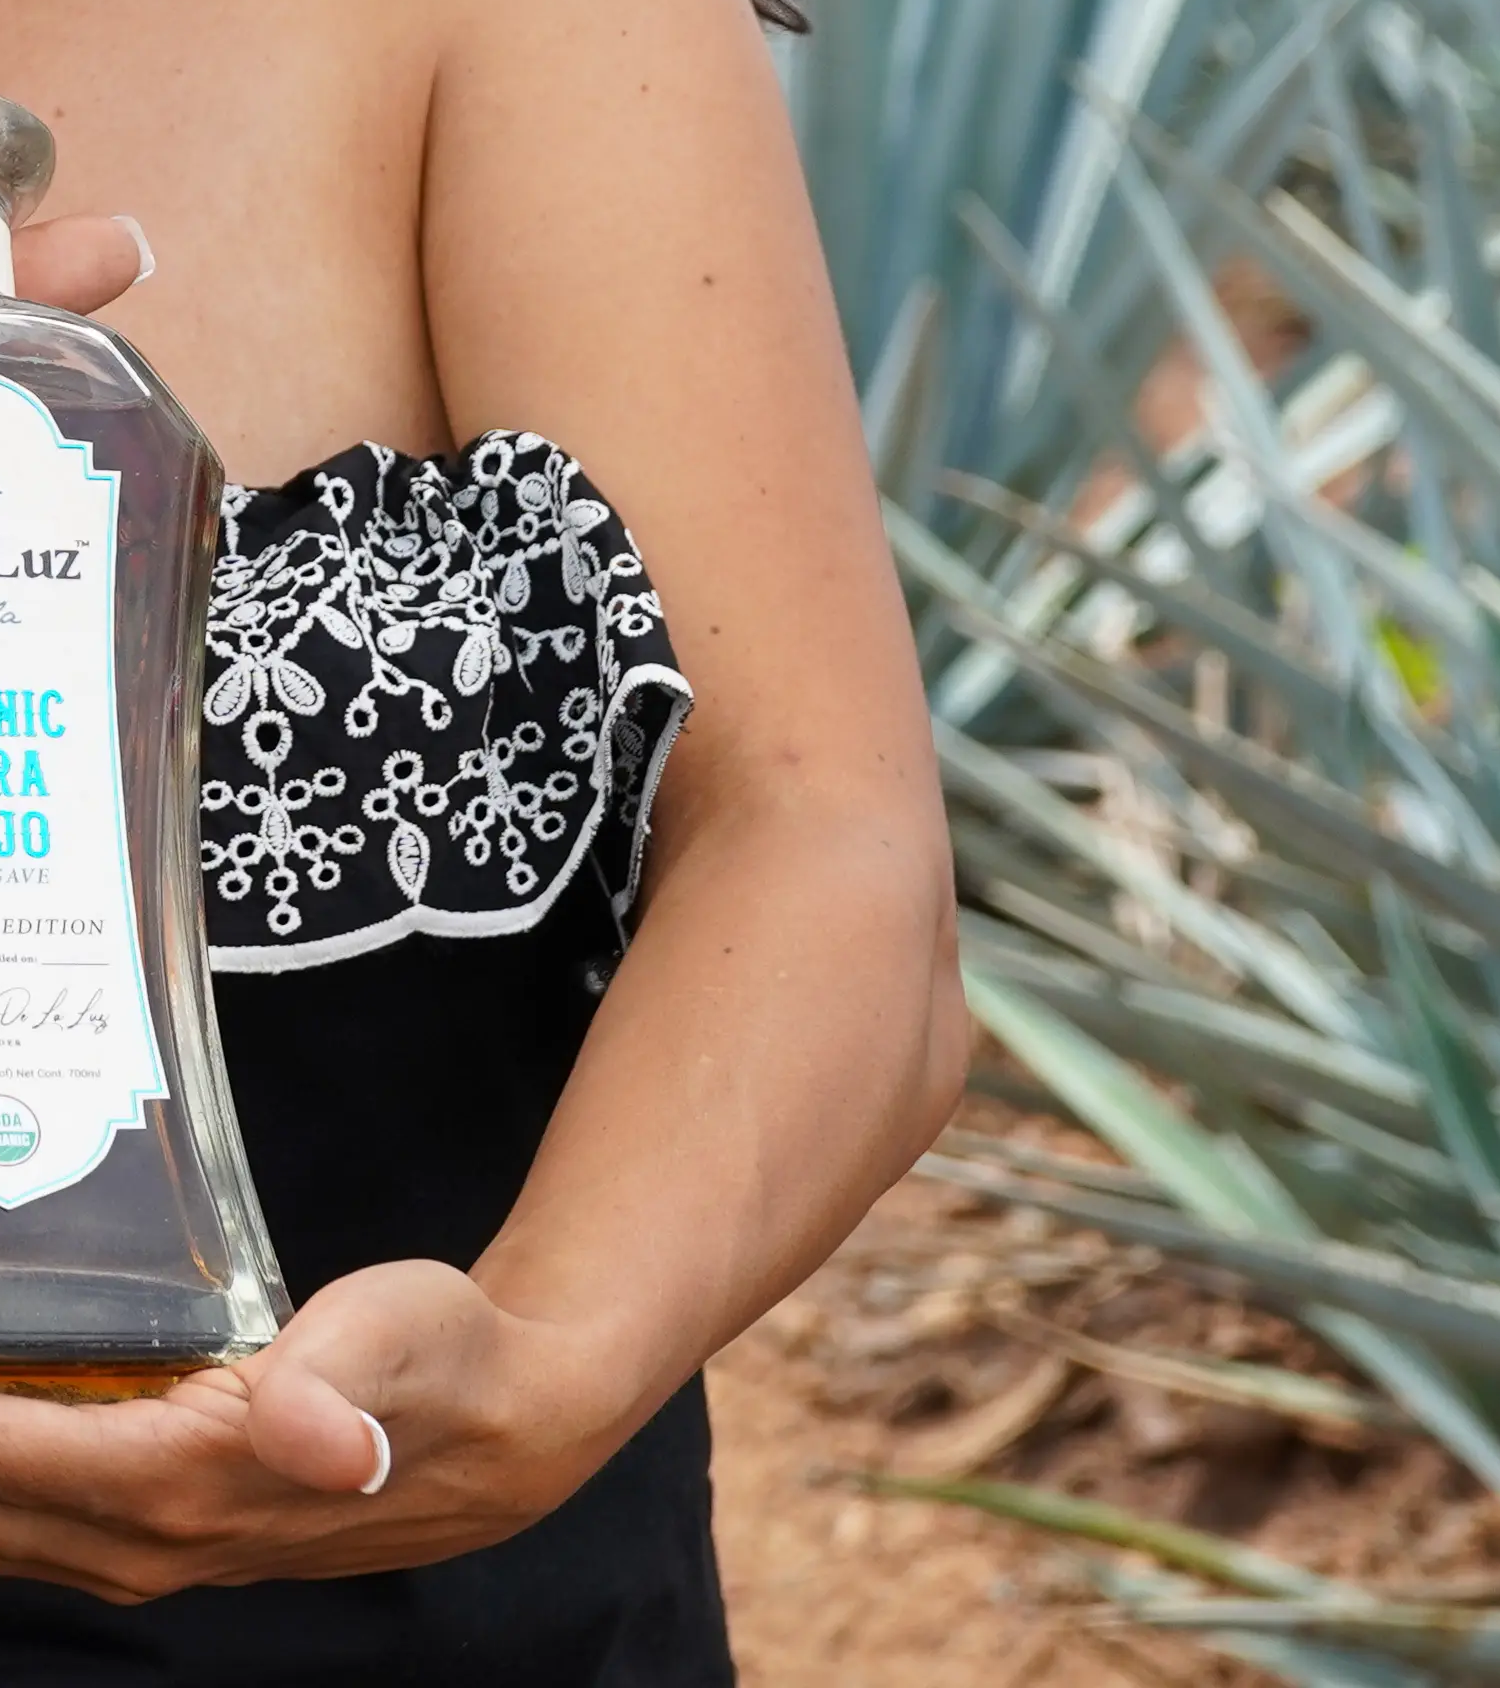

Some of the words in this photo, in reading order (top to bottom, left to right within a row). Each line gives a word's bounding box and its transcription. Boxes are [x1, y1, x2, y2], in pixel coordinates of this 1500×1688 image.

[2, 918, 106, 936] EDITION
[16, 1069, 34, 1078] Net
[69, 1069, 101, 1078] 700ml
